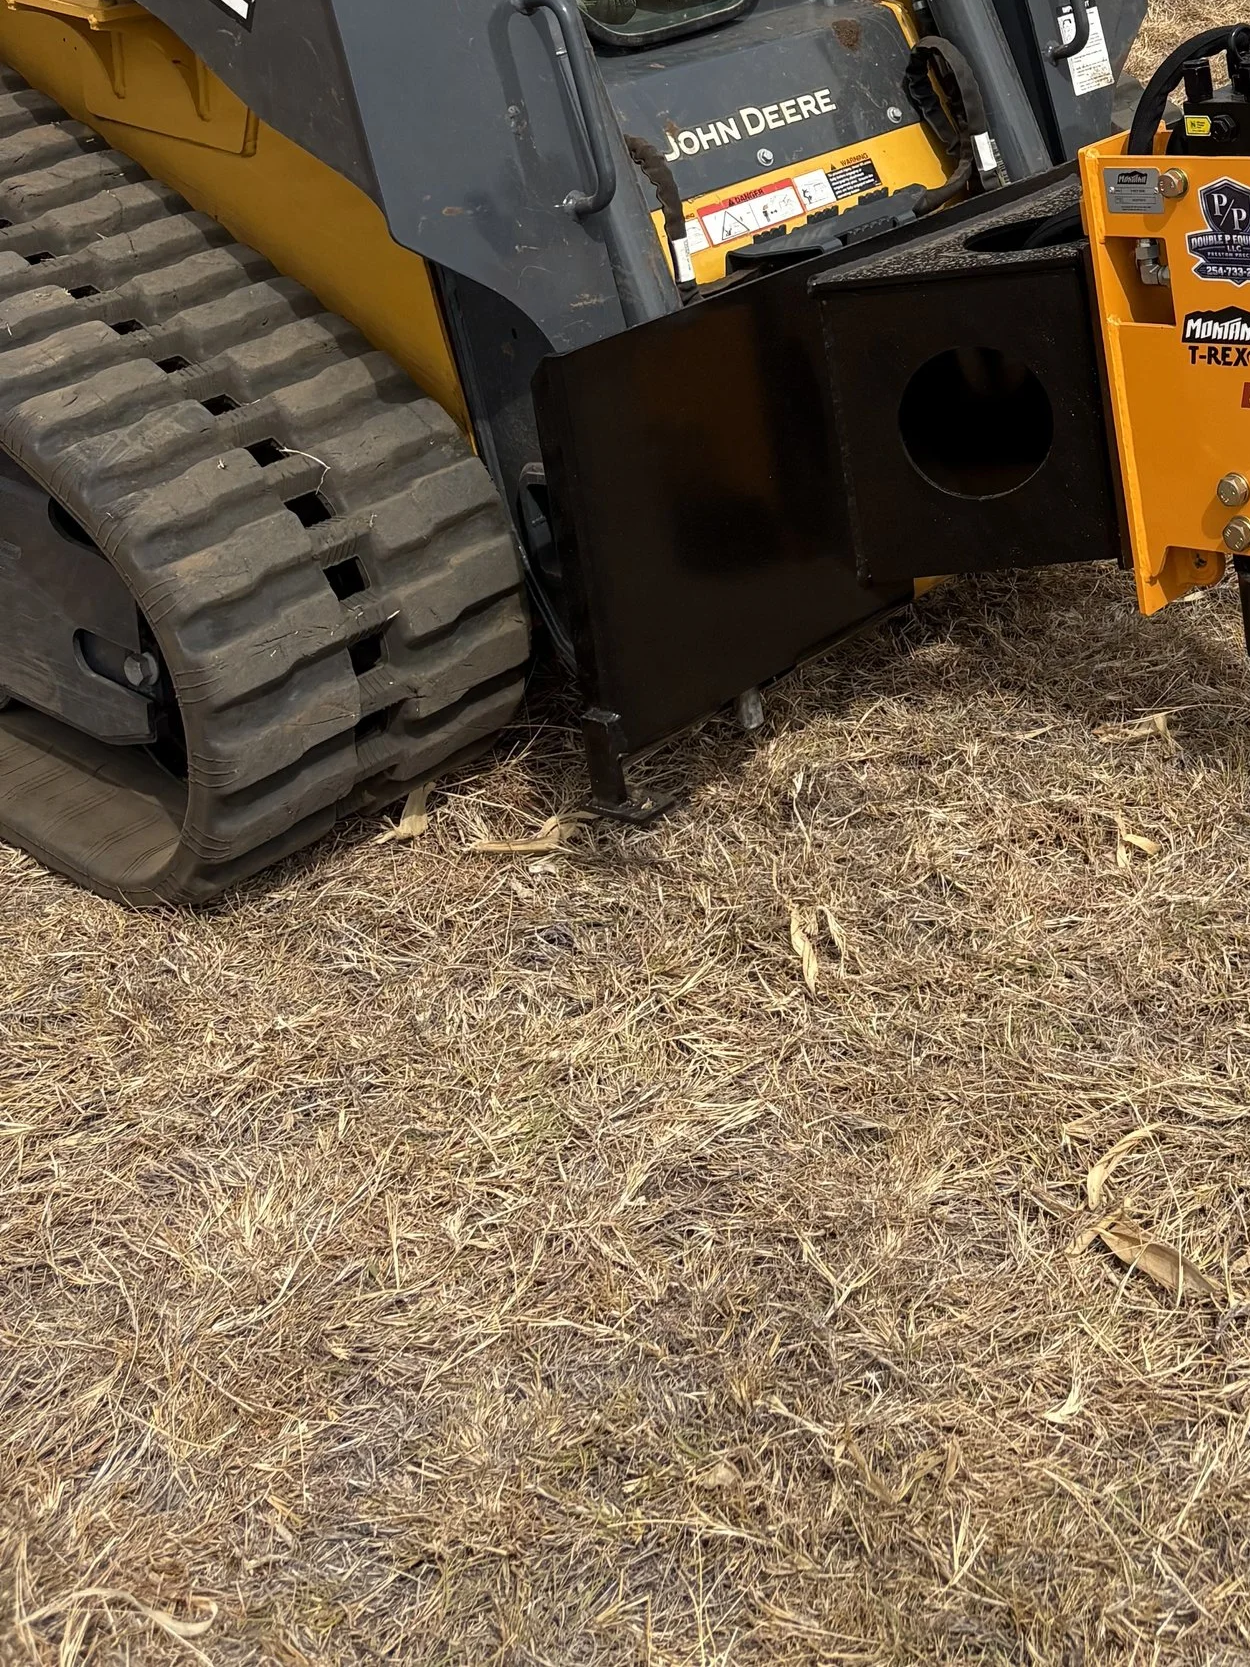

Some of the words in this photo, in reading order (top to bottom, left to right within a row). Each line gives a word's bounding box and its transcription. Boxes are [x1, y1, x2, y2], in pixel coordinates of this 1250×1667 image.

[664, 117, 742, 162] JOHN
[739, 88, 837, 136] DEERE
[840, 152, 869, 166] WARNING
[734, 188, 764, 205] DANGER
[1191, 234, 1224, 249] DOUBLE
[1224, 234, 1231, 244] P
[1188, 345, 1249, 367] T-REX
